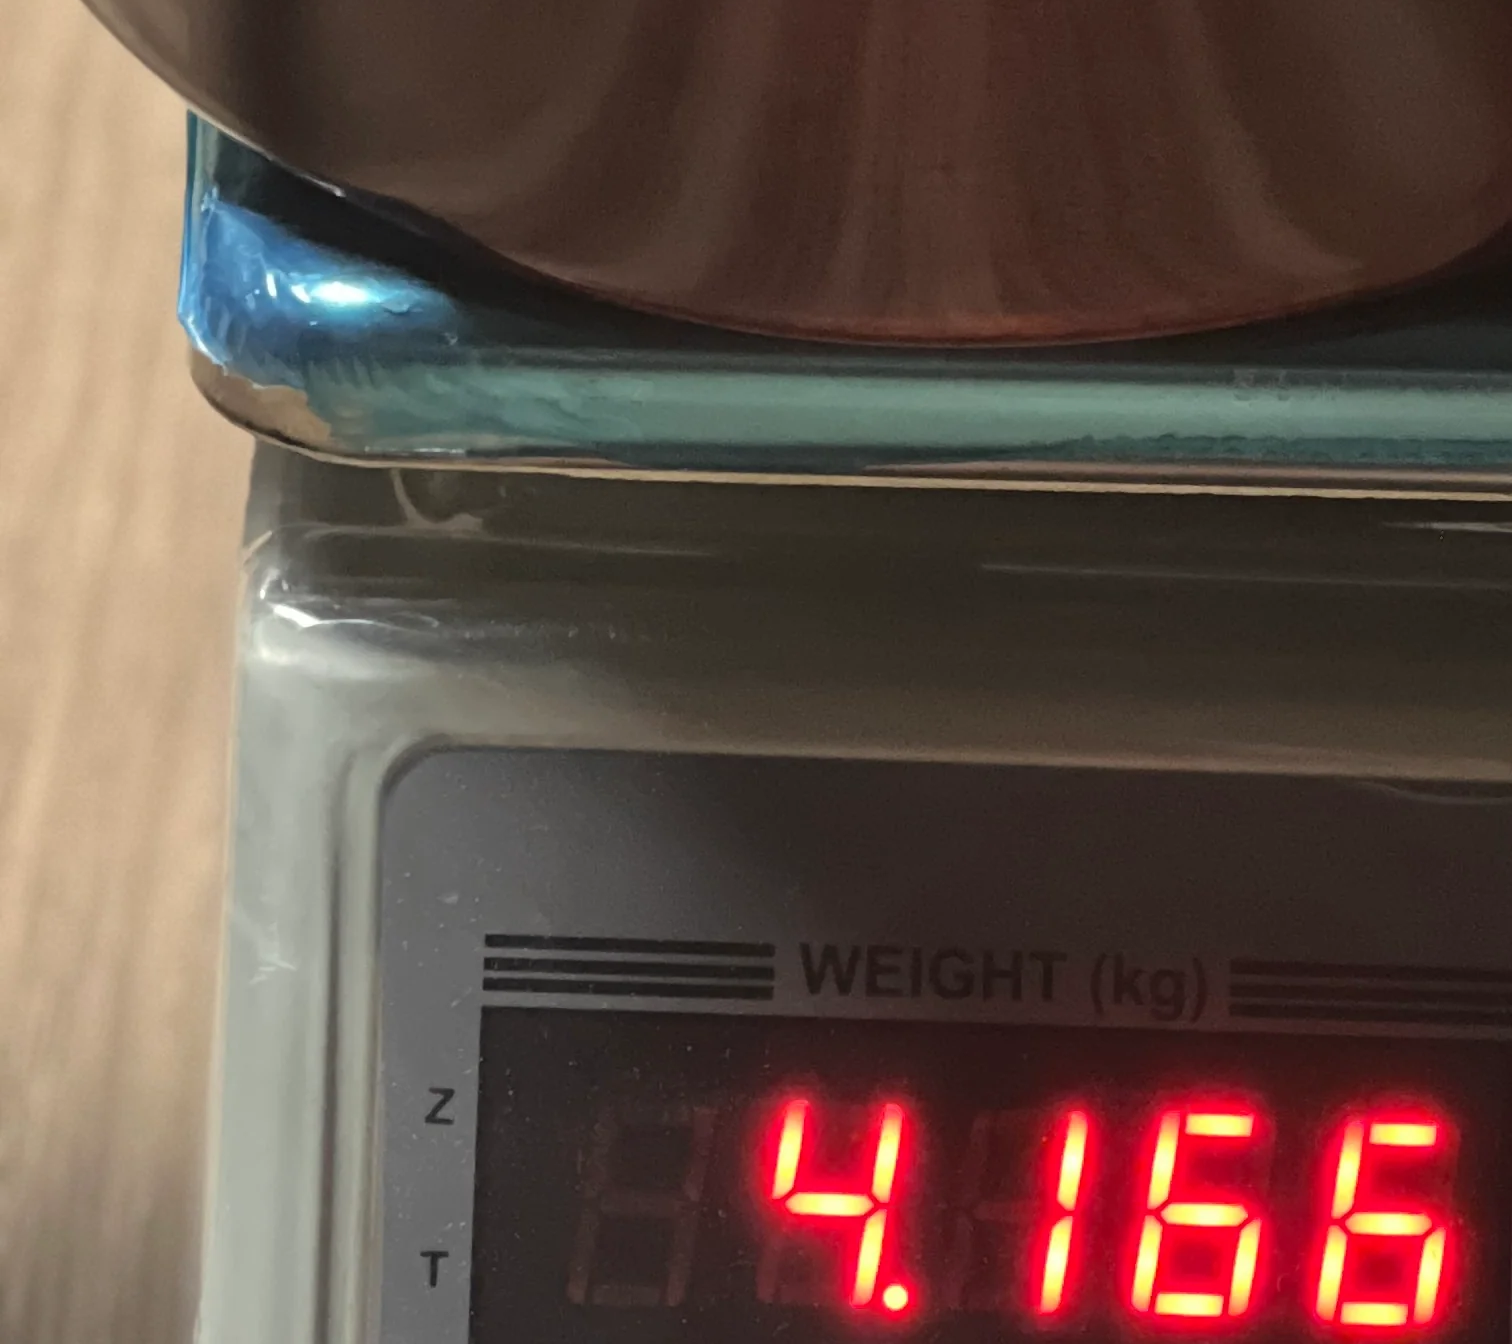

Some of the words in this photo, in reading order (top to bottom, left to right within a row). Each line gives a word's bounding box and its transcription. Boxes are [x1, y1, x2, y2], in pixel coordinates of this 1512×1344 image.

[800, 942, 1069, 1005] WEIGHT
[1090, 954, 1210, 1024] (kg)
[424, 1087, 457, 1127] Z
[770, 1097, 1448, 1330] 4.166
[421, 1251, 450, 1290] T
